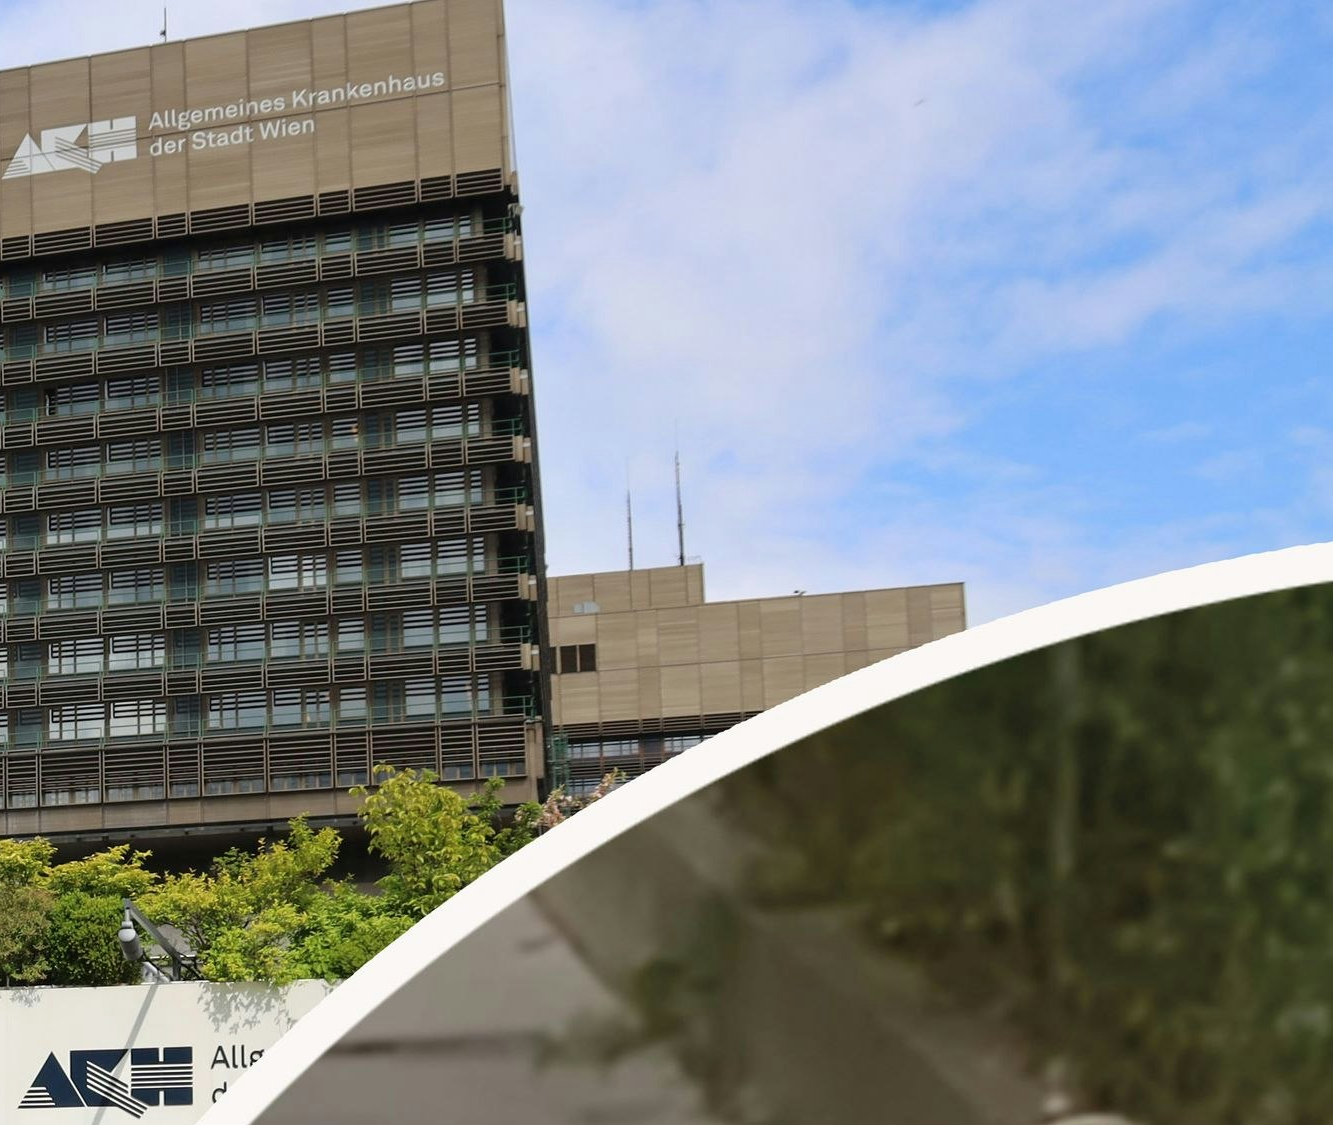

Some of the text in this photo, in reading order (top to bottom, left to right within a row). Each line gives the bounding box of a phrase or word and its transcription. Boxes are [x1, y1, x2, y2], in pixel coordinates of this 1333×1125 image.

[148, 71, 446, 131] Allgemeines Krankenhaus
[149, 118, 315, 157] der Stadt Wien
